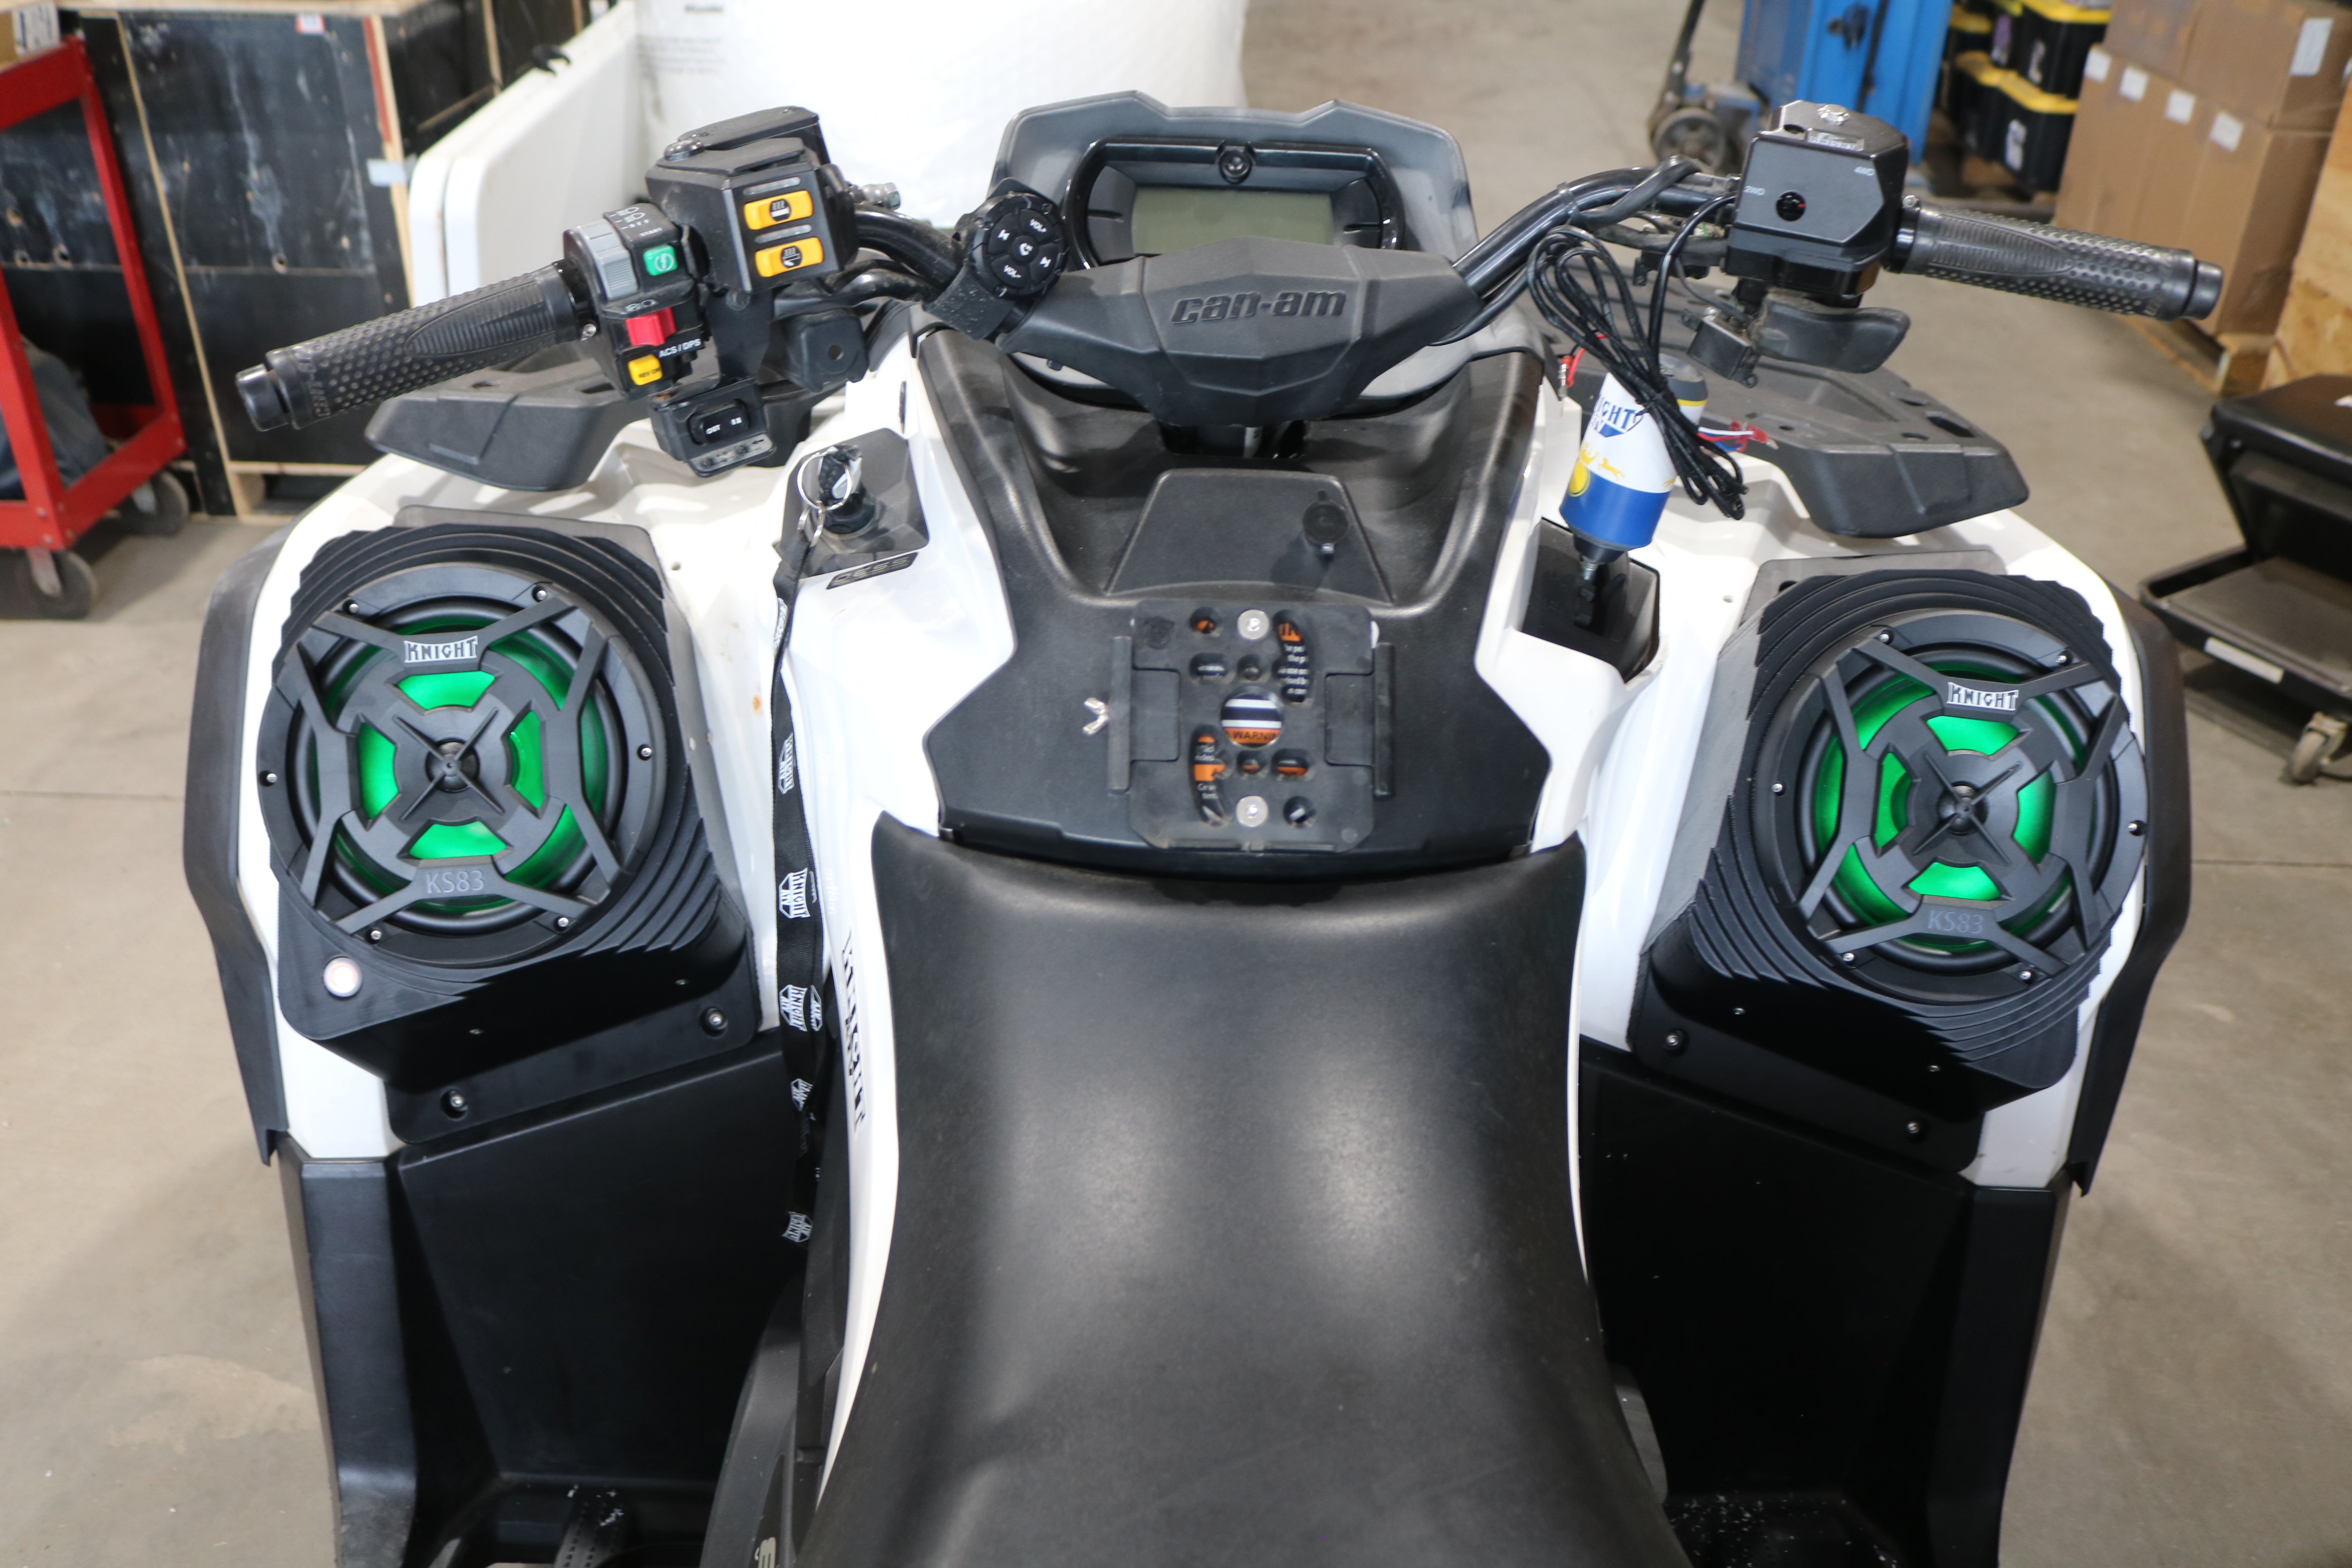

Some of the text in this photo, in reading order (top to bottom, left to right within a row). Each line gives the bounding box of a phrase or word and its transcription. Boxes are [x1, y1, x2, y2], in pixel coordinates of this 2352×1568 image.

[405, 637, 477, 662] KNIGHT
[1947, 682, 2018, 711] KNIGHT
[426, 870, 485, 894] KS83
[791, 867, 811, 918] KNIGHT
[1927, 909, 1983, 934] KS83
